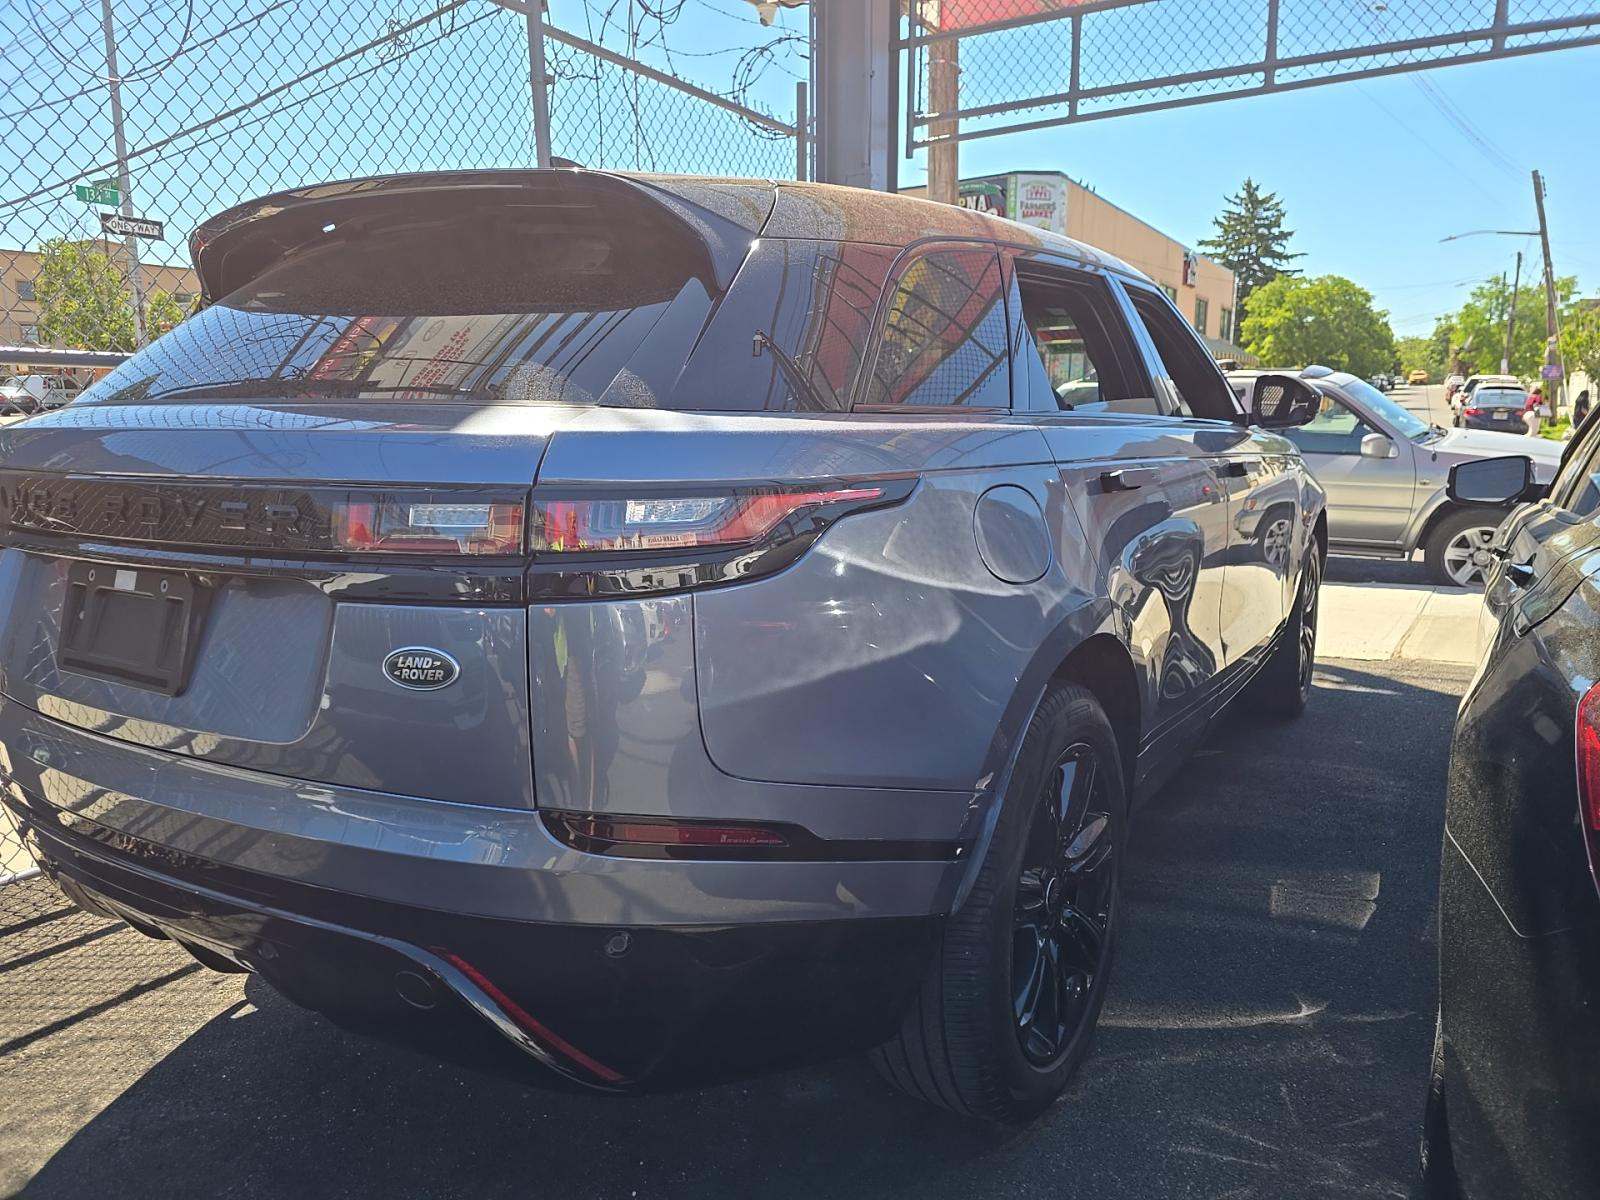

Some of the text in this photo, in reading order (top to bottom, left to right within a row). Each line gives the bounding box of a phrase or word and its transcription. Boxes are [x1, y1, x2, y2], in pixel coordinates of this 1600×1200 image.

[111, 220, 155, 235] ONE WAY
[103, 493, 300, 533] ROVER
[397, 656, 433, 669] LAND
[401, 668, 444, 681] ROVER
